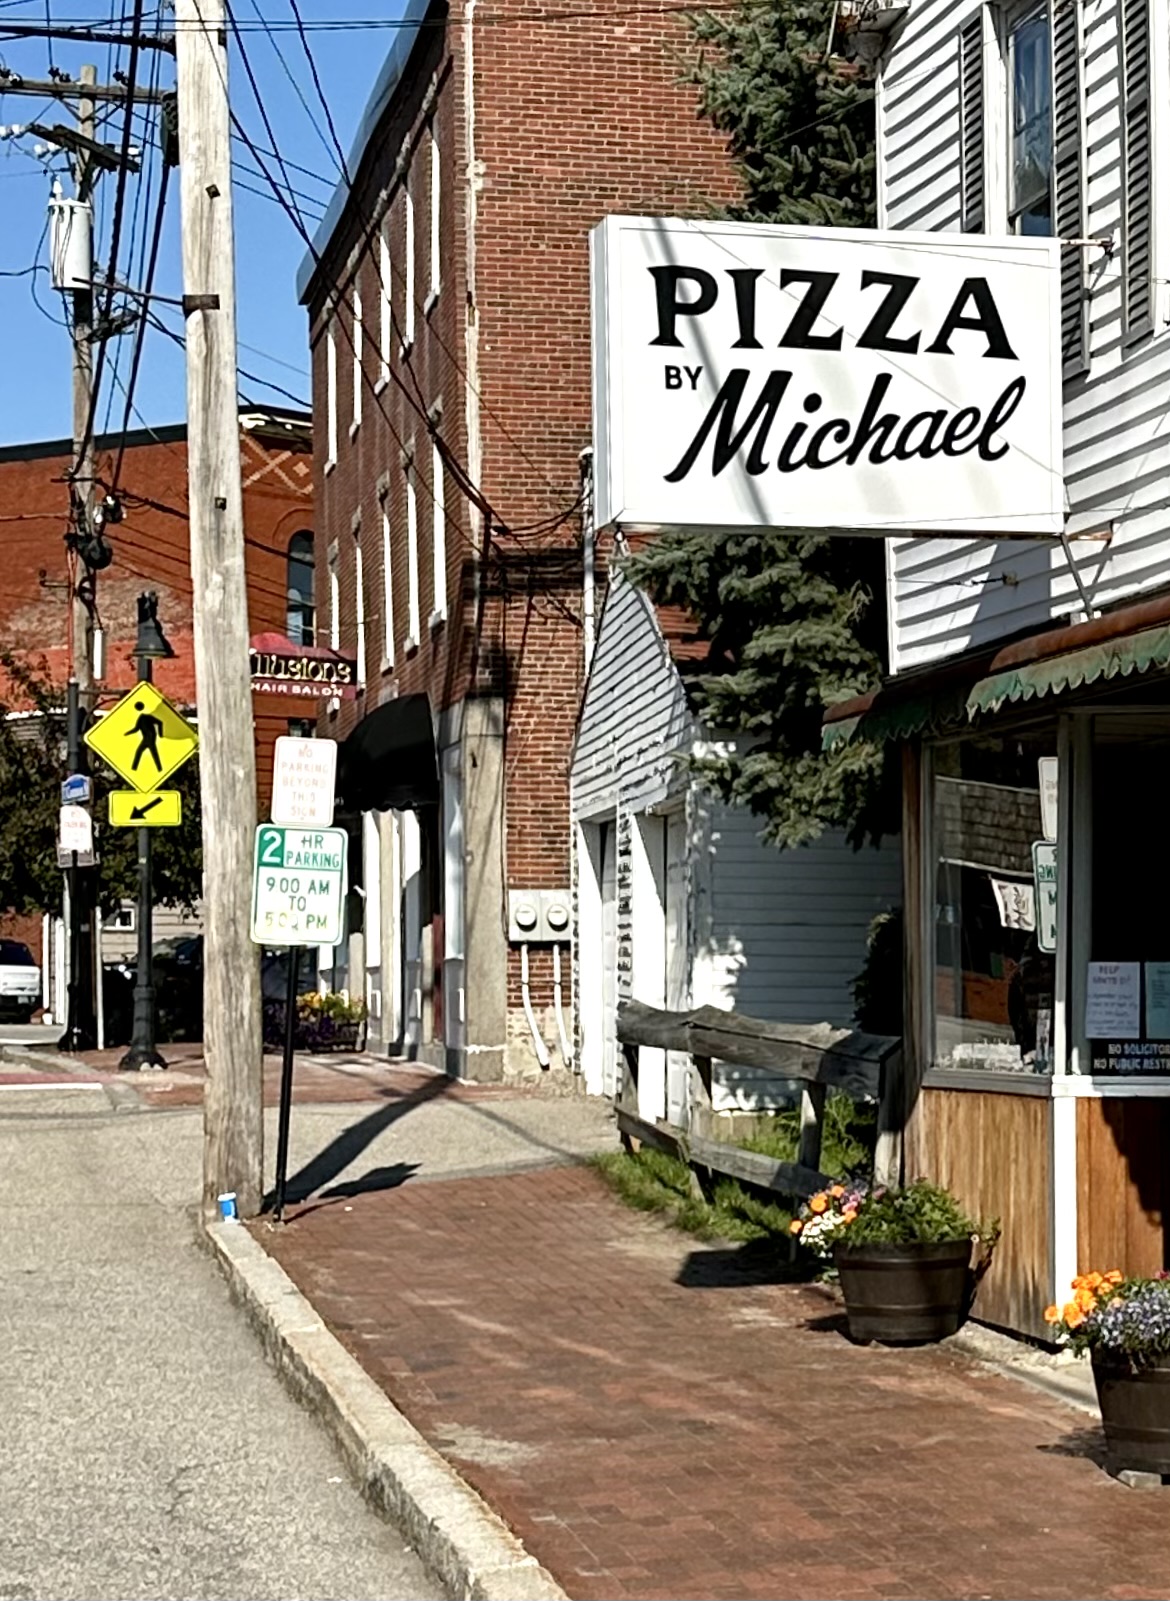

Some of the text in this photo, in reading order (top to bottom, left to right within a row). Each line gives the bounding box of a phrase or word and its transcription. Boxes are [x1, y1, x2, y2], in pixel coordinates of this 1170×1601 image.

[646, 264, 1020, 361] PIZZA
[662, 364, 1027, 484] BY Michael
[248, 648, 352, 684] llusions
[249, 682, 344, 697] HAIR SALON
[292, 791, 316, 803] THS
[261, 830, 282, 863] 2
[301, 834, 324, 849] HR
[286, 850, 340, 868] PARKING
[307, 879, 330, 896] AM
[288, 895, 307, 912] TO
[305, 914, 328, 930] PM
[1107, 1043, 1122, 1055] NO
[1093, 1057, 1107, 1070] NO
[1108, 1057, 1141, 1070] PUBLIC
